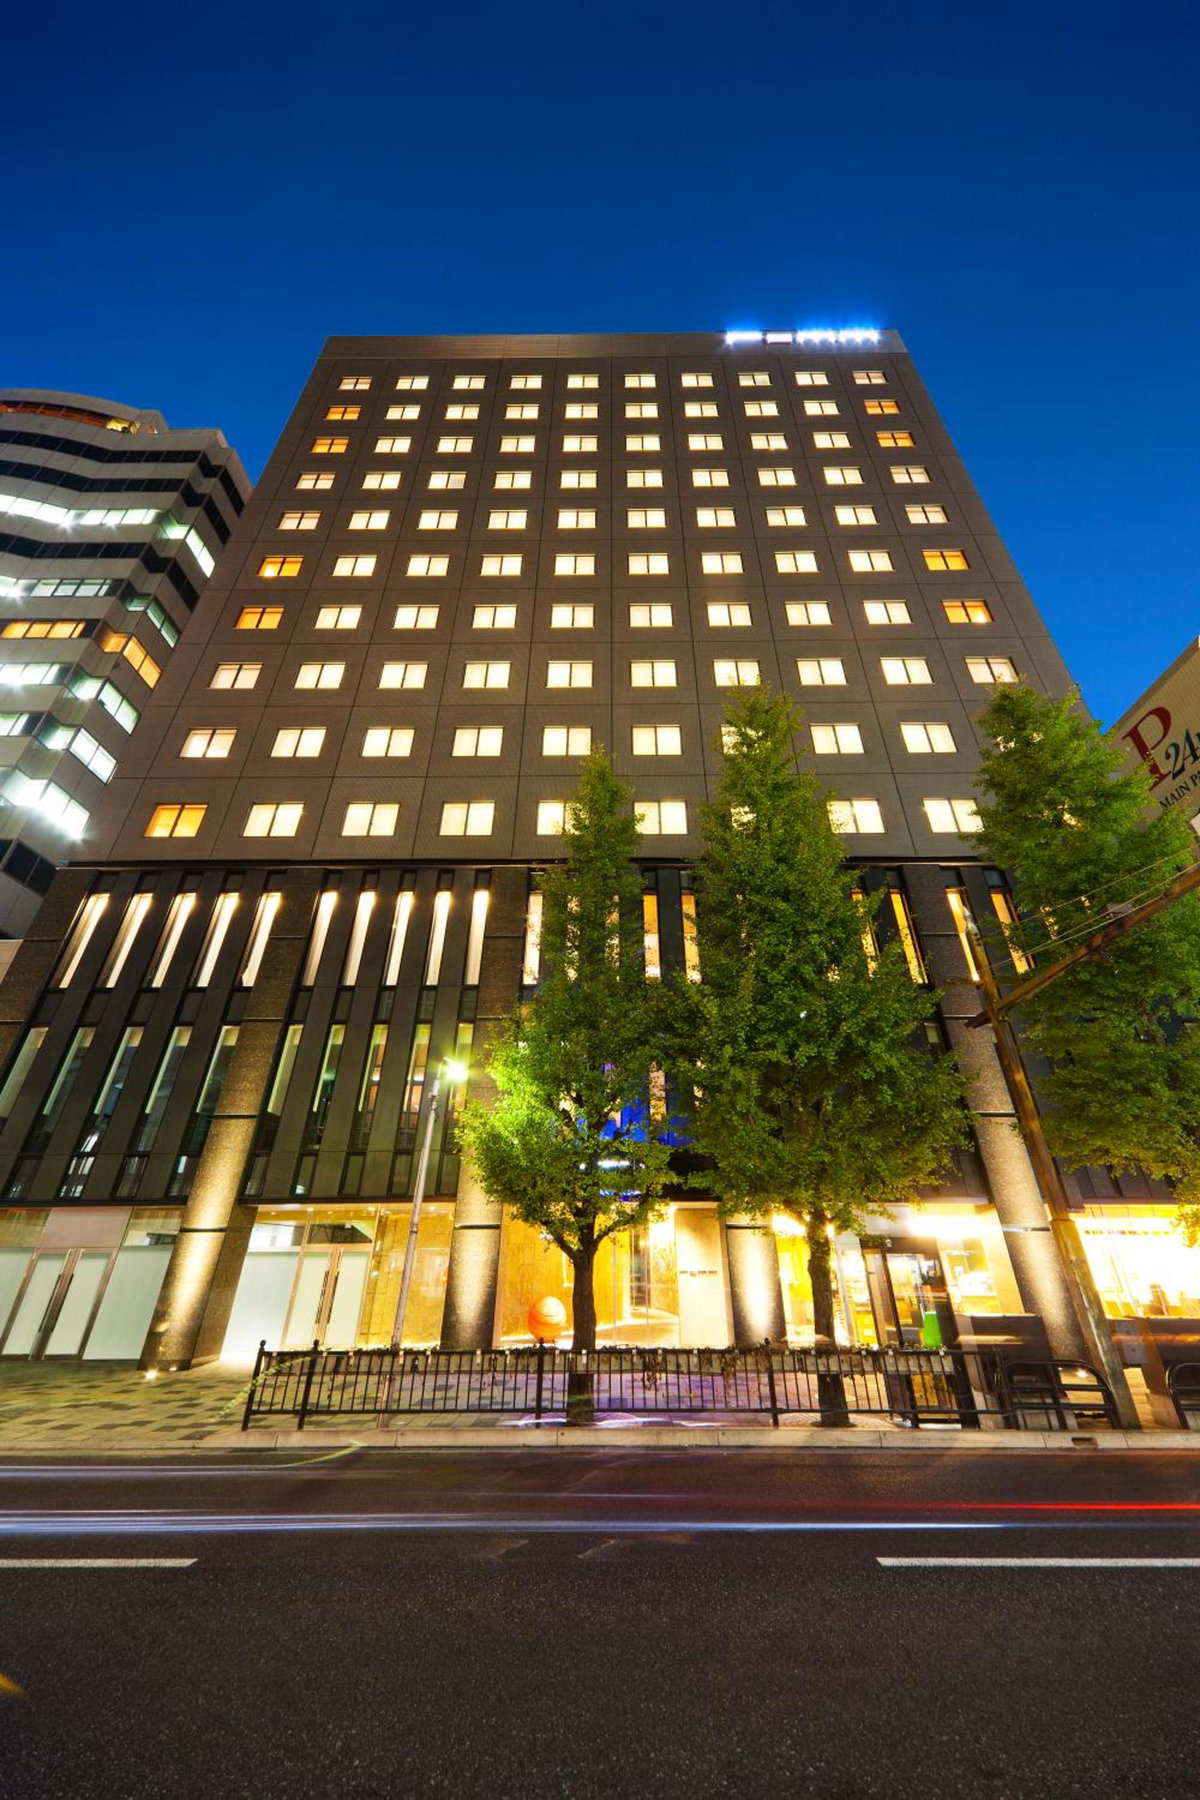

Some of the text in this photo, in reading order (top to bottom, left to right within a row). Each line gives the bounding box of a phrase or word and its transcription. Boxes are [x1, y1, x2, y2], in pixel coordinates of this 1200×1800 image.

[1122, 707, 1200, 791] P 24
[1159, 781, 1191, 808] MAIN
